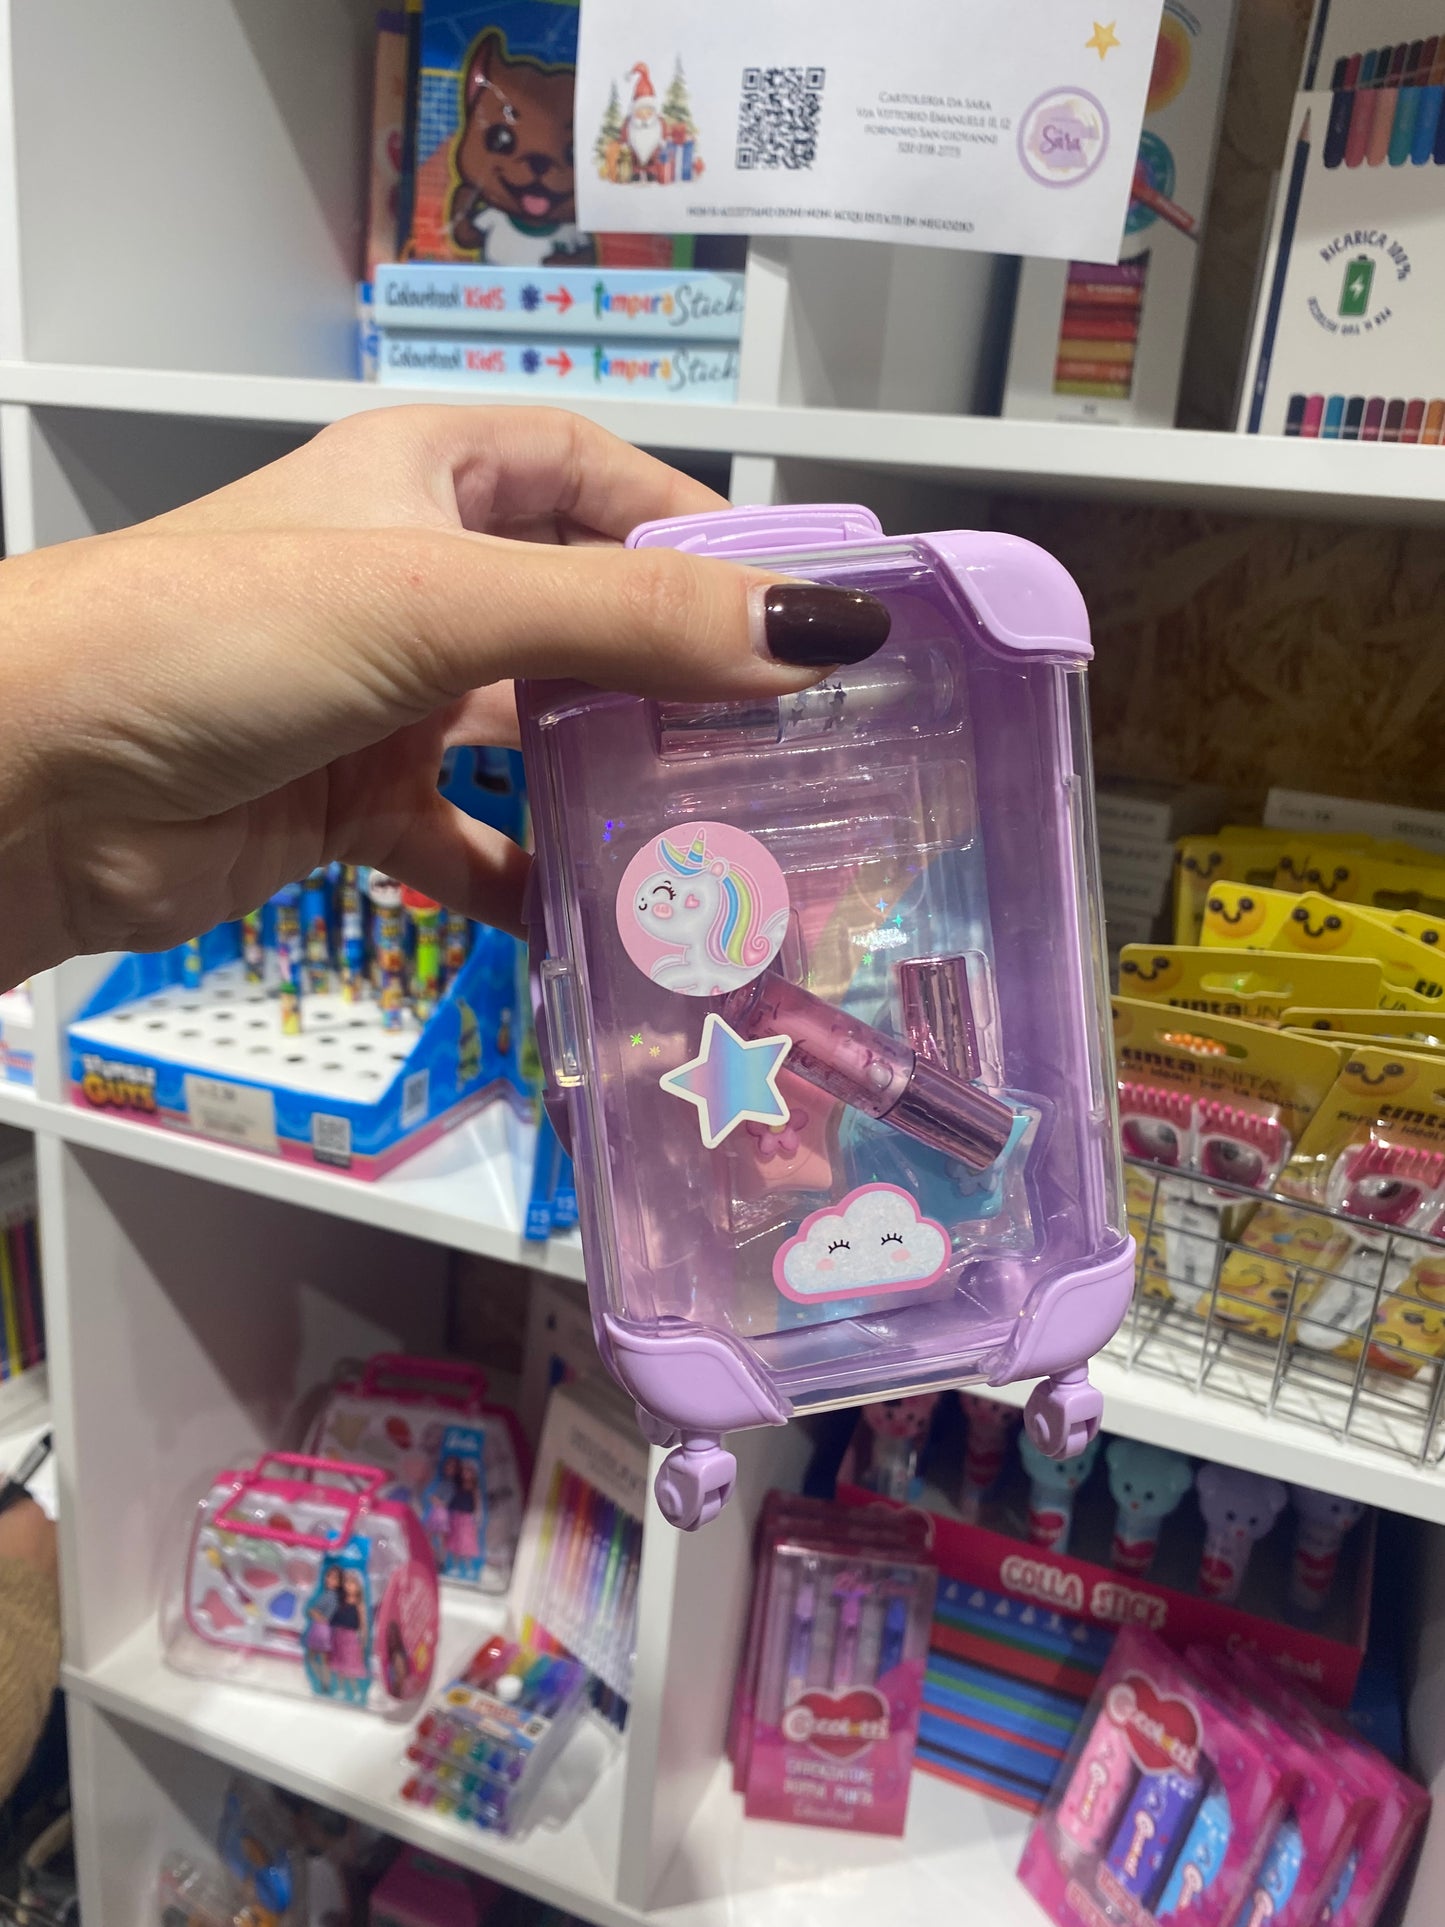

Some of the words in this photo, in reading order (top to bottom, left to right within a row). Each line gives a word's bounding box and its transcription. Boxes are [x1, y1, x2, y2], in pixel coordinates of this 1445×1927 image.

[1039, 124, 1084, 154] Sara
[1319, 229, 1388, 263] RICARICA
[1001, 1554, 1085, 1612] COLLA
